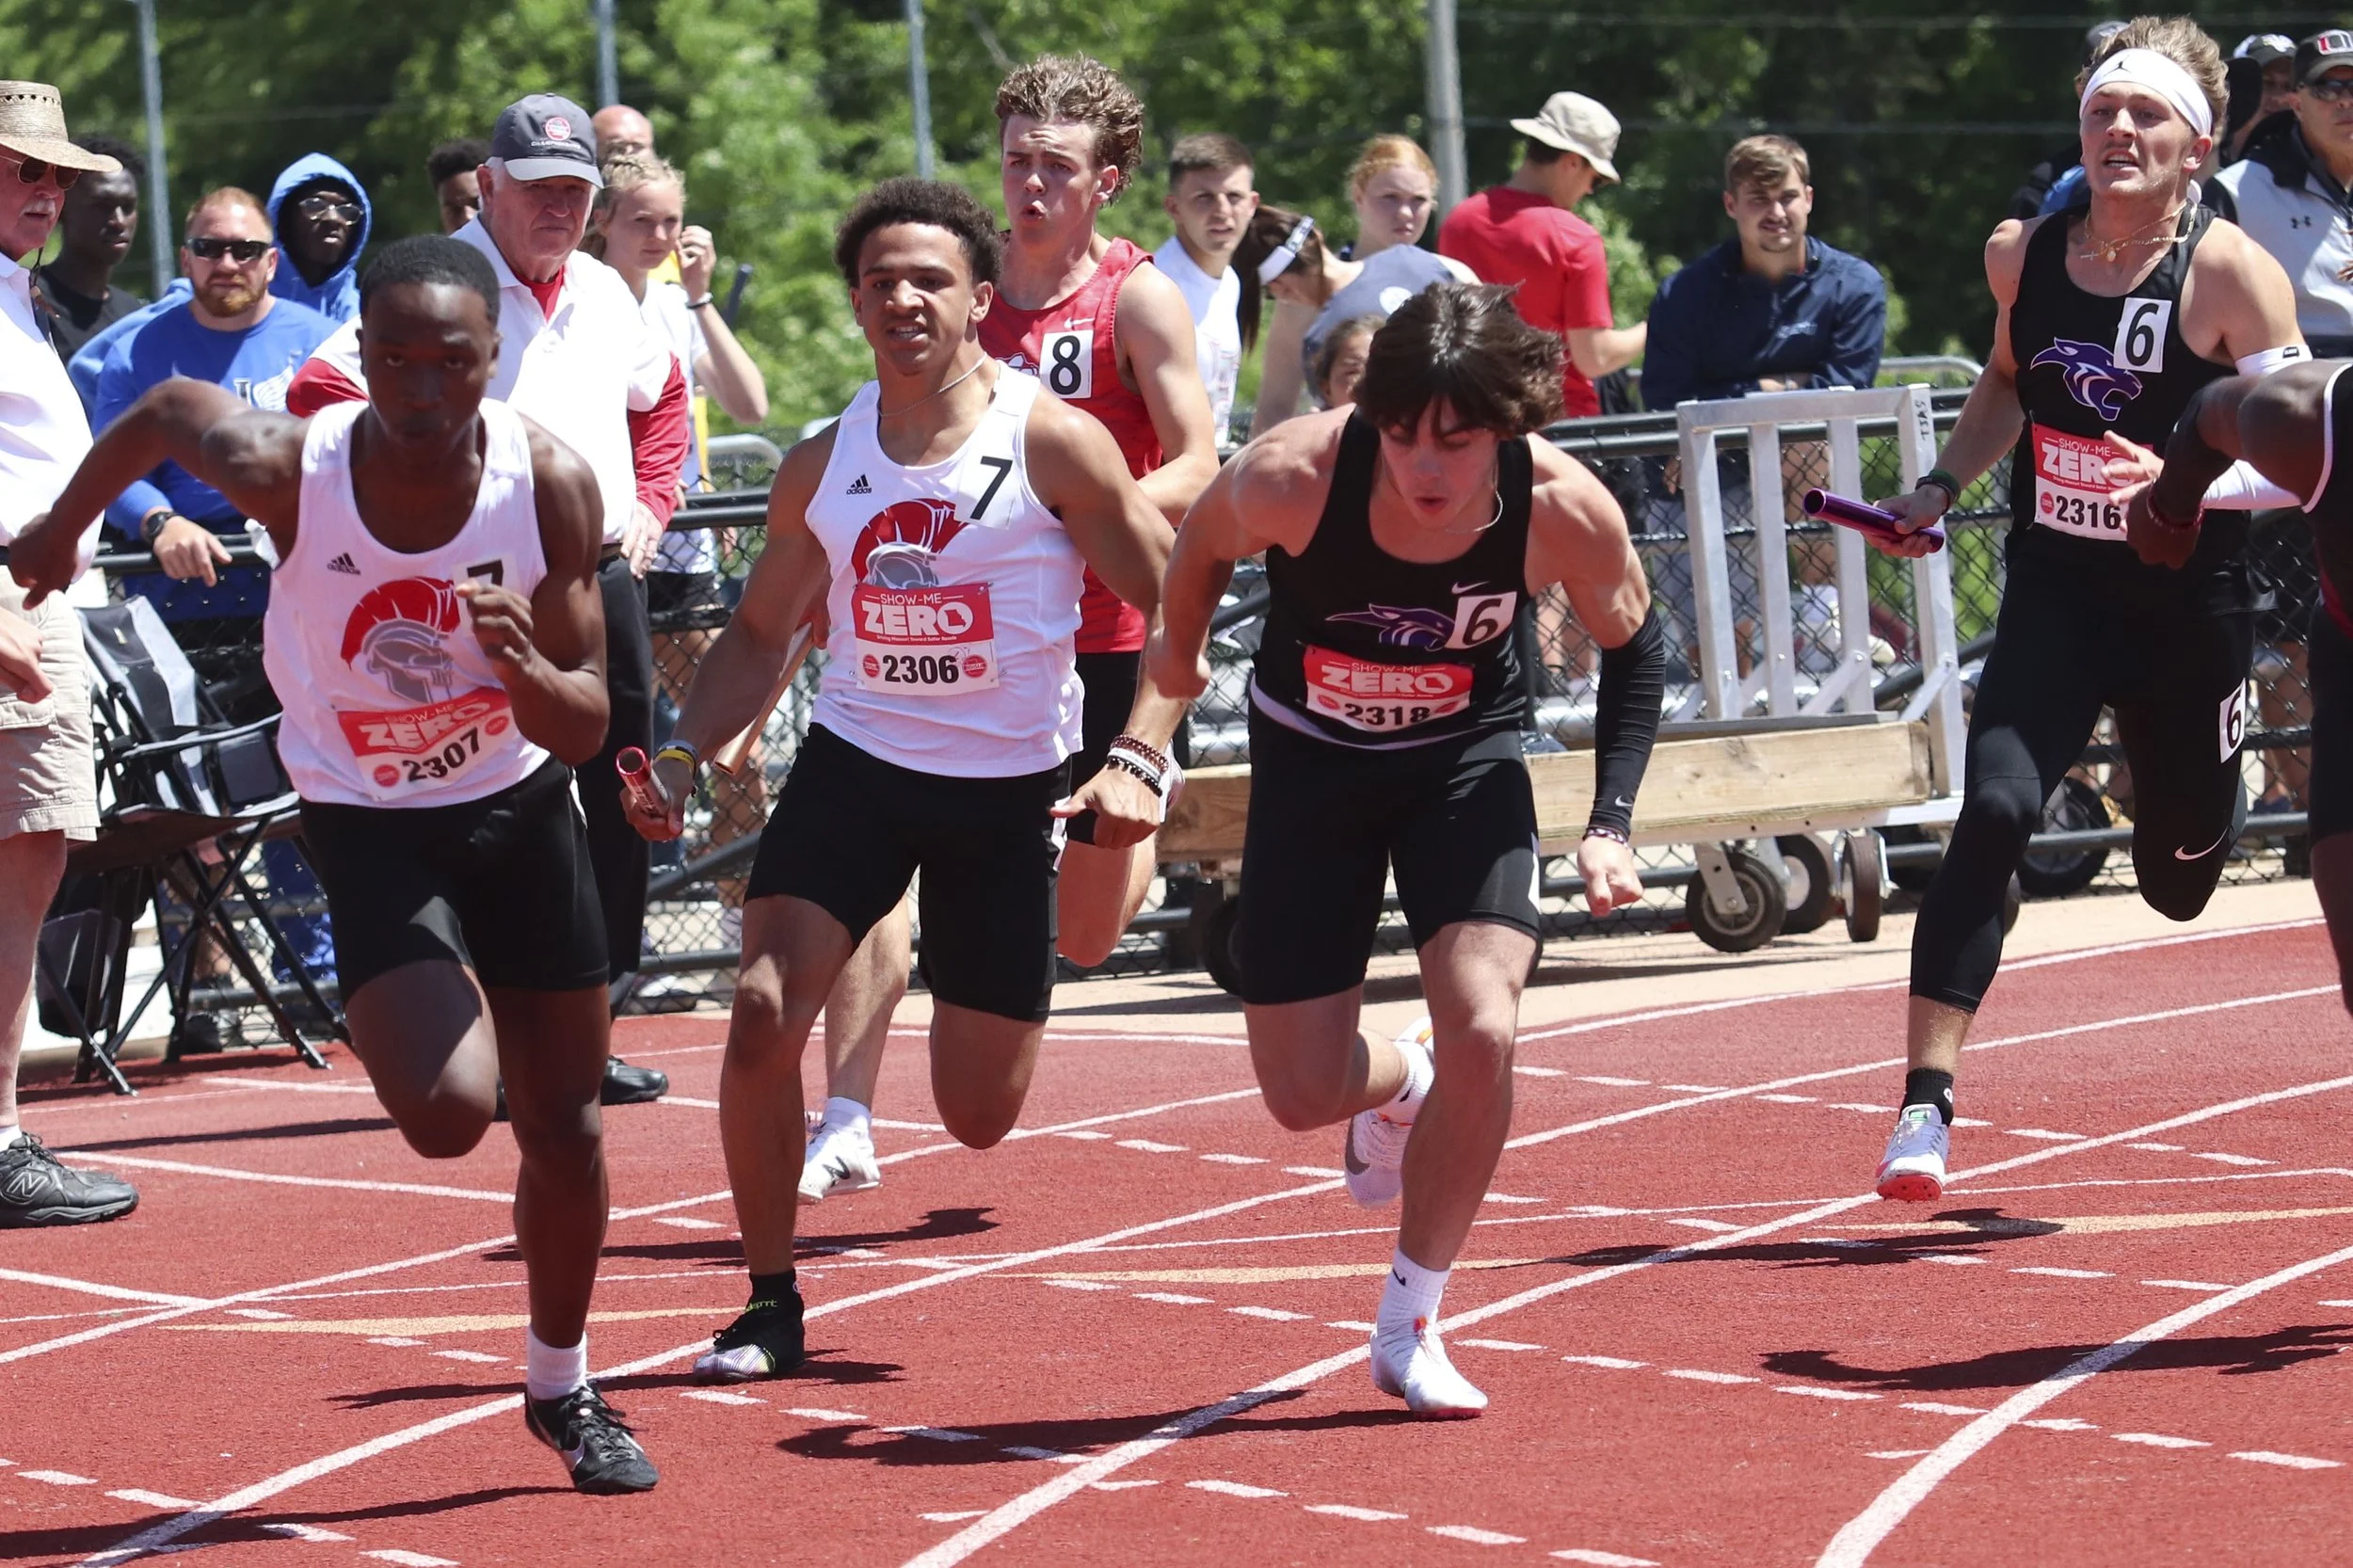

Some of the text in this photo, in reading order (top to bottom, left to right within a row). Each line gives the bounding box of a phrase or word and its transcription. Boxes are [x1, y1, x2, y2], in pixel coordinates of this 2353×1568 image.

[2125, 302, 2160, 366] 6
[1049, 335, 1081, 394] 8
[2058, 438, 2111, 456] SHOW-ME
[846, 487, 872, 495] adidas
[969, 456, 1013, 520] 7
[2056, 495, 2121, 530] 2316
[880, 593, 942, 604] SHOW-ME
[861, 600, 974, 636] ZERO
[1462, 598, 1503, 646] 6
[882, 654, 959, 684] 2306
[1321, 664, 1453, 694] ZERO
[1351, 662, 1423, 673] SHOW-ME
[358, 702, 490, 748] ZERO
[1344, 703, 1431, 726] 2318
[2226, 688, 2241, 749] 6
[402, 727, 480, 783] 2307
